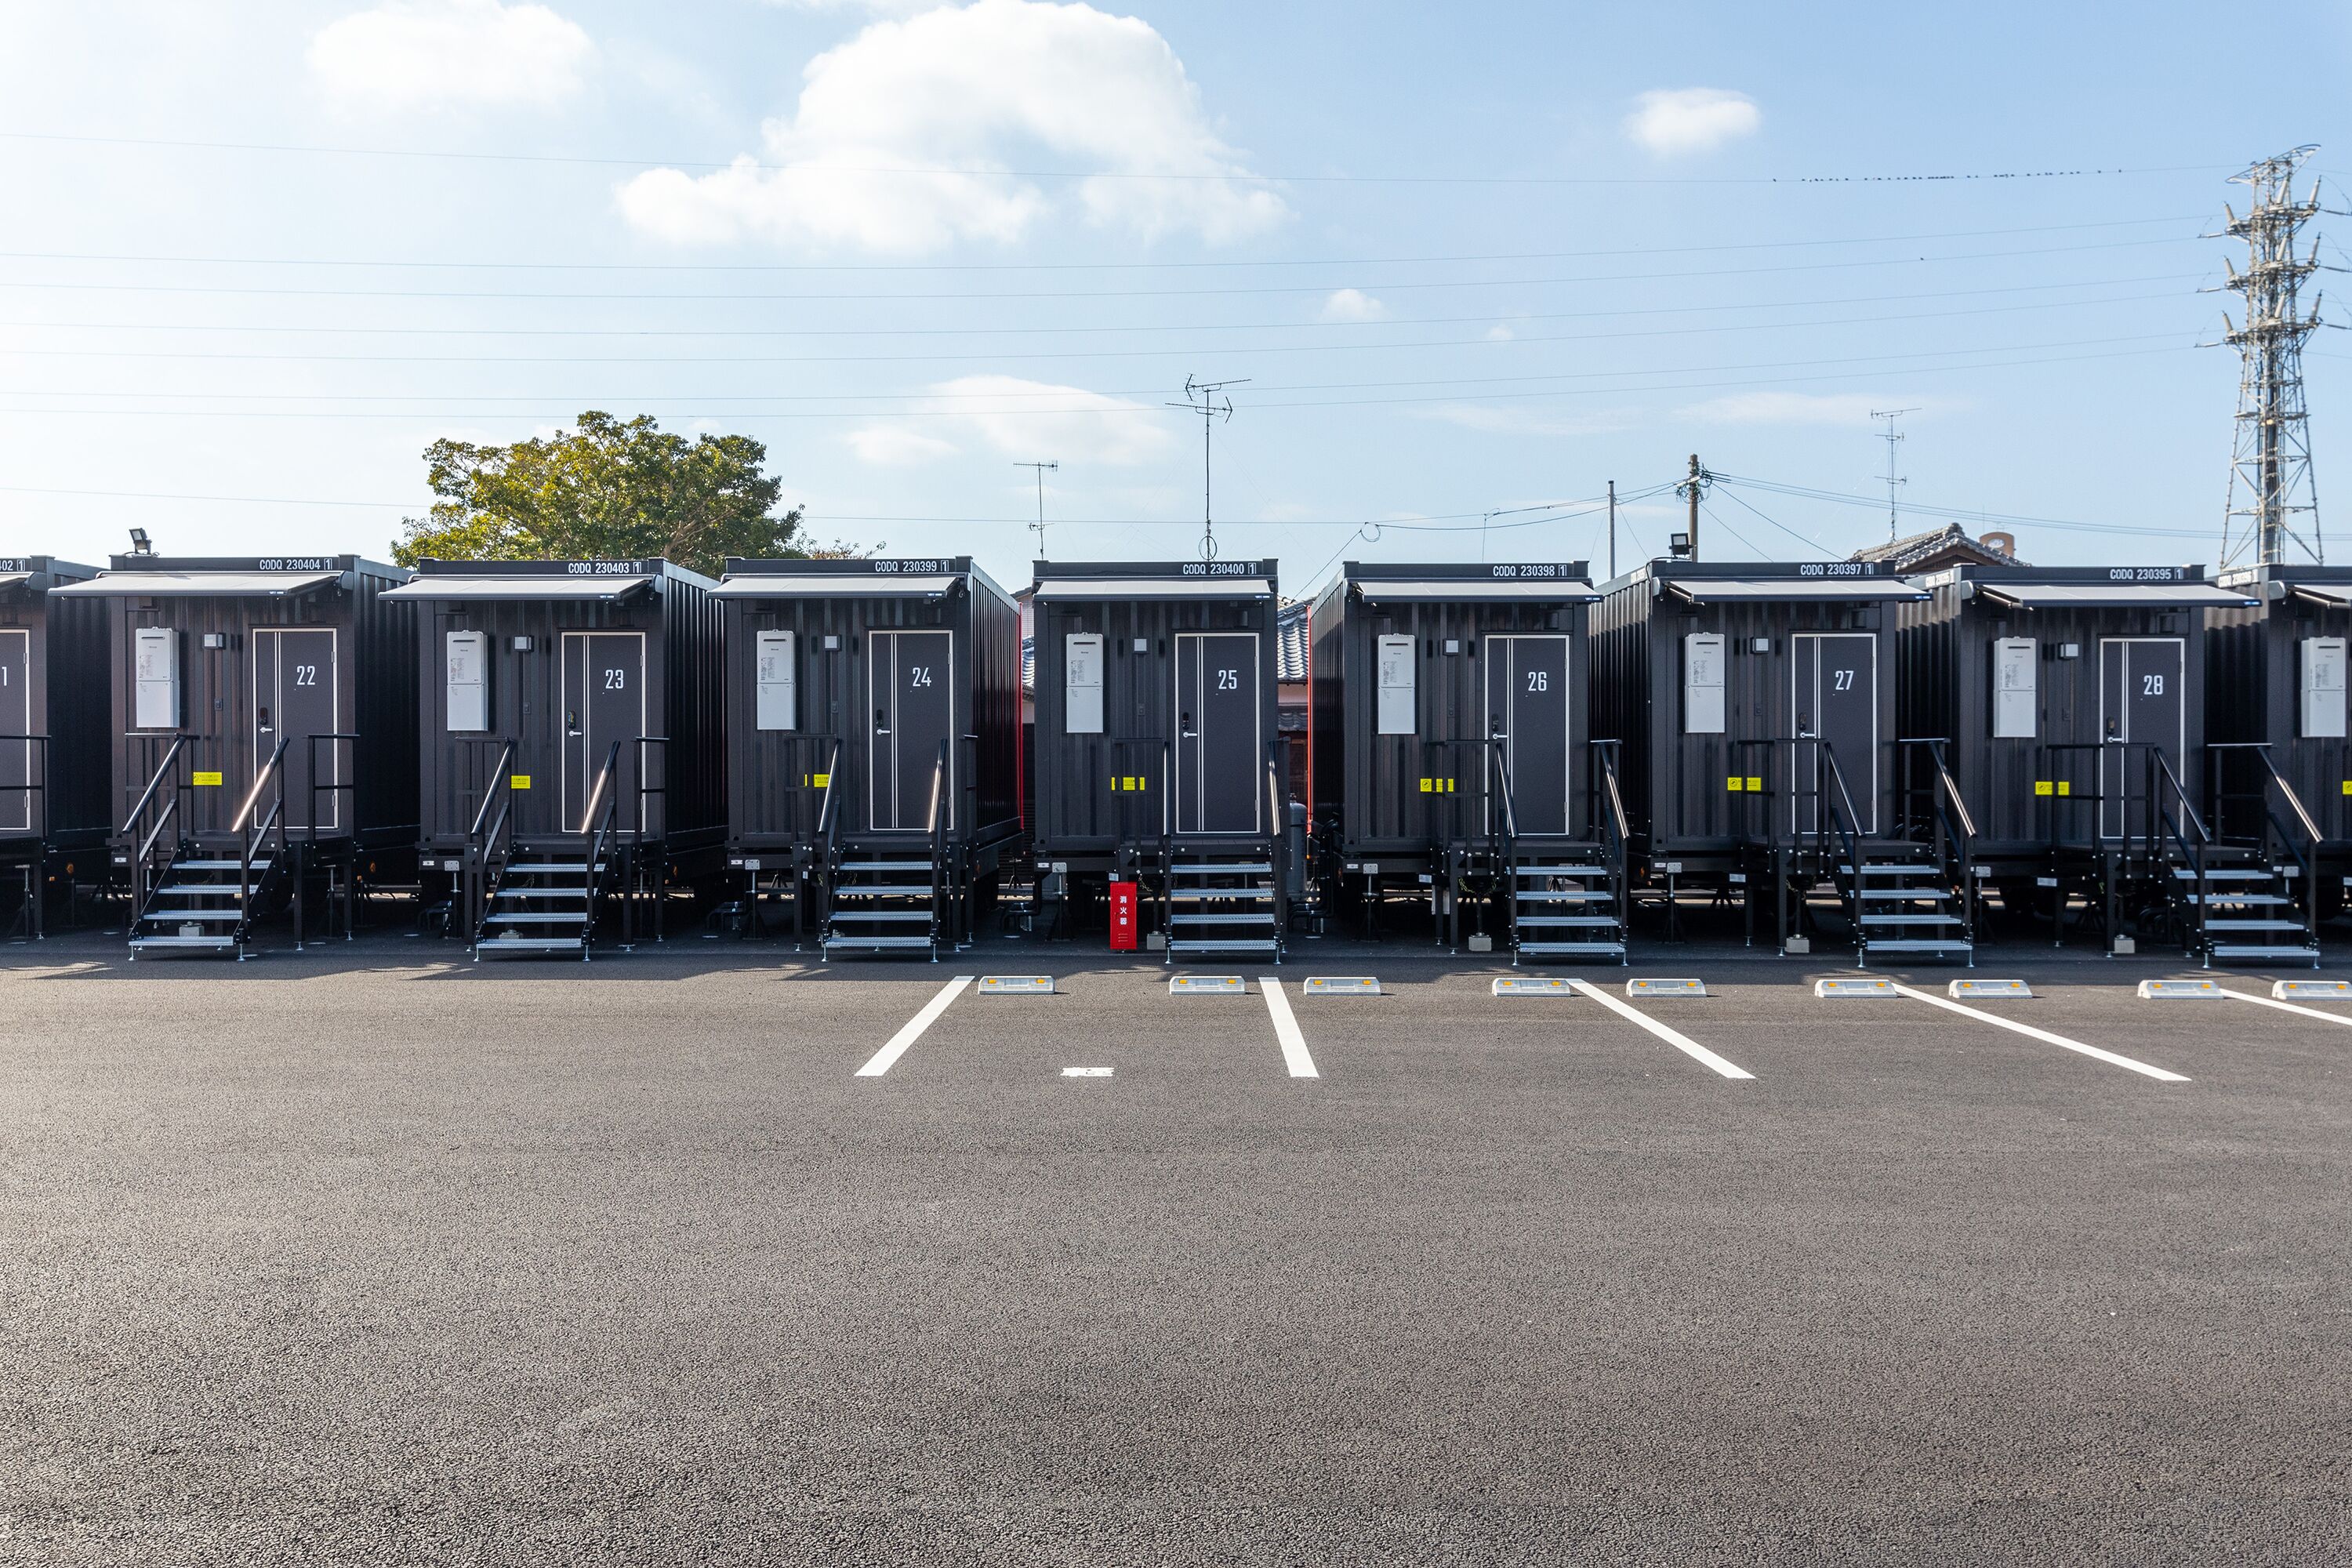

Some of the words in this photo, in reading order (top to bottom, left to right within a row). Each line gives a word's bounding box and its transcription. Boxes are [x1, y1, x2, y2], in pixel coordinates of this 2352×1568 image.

[260, 559, 283, 570] CODQ
[287, 559, 321, 570] 230404
[568, 562, 591, 574] CODQ
[595, 562, 630, 574] 230403
[875, 561, 898, 572] CODQ
[902, 561, 937, 572] 230399
[1182, 564, 1206, 575] CODQ
[1210, 564, 1244, 575] 230400
[1493, 565, 1516, 576] CODQ
[1520, 564, 1555, 576] 230398
[1800, 564, 1824, 575] CODQ
[1828, 564, 1861, 575] 230397
[2110, 568, 2133, 580] CODQ
[2136, 568, 2172, 580] 230395
[296, 666, 316, 686] 22
[605, 670, 624, 689] 23
[913, 666, 932, 687] 24
[1218, 670, 1238, 690] 25
[1528, 671, 1547, 691] 26
[1835, 670, 1855, 690] 27
[2143, 674, 2164, 695] 28
